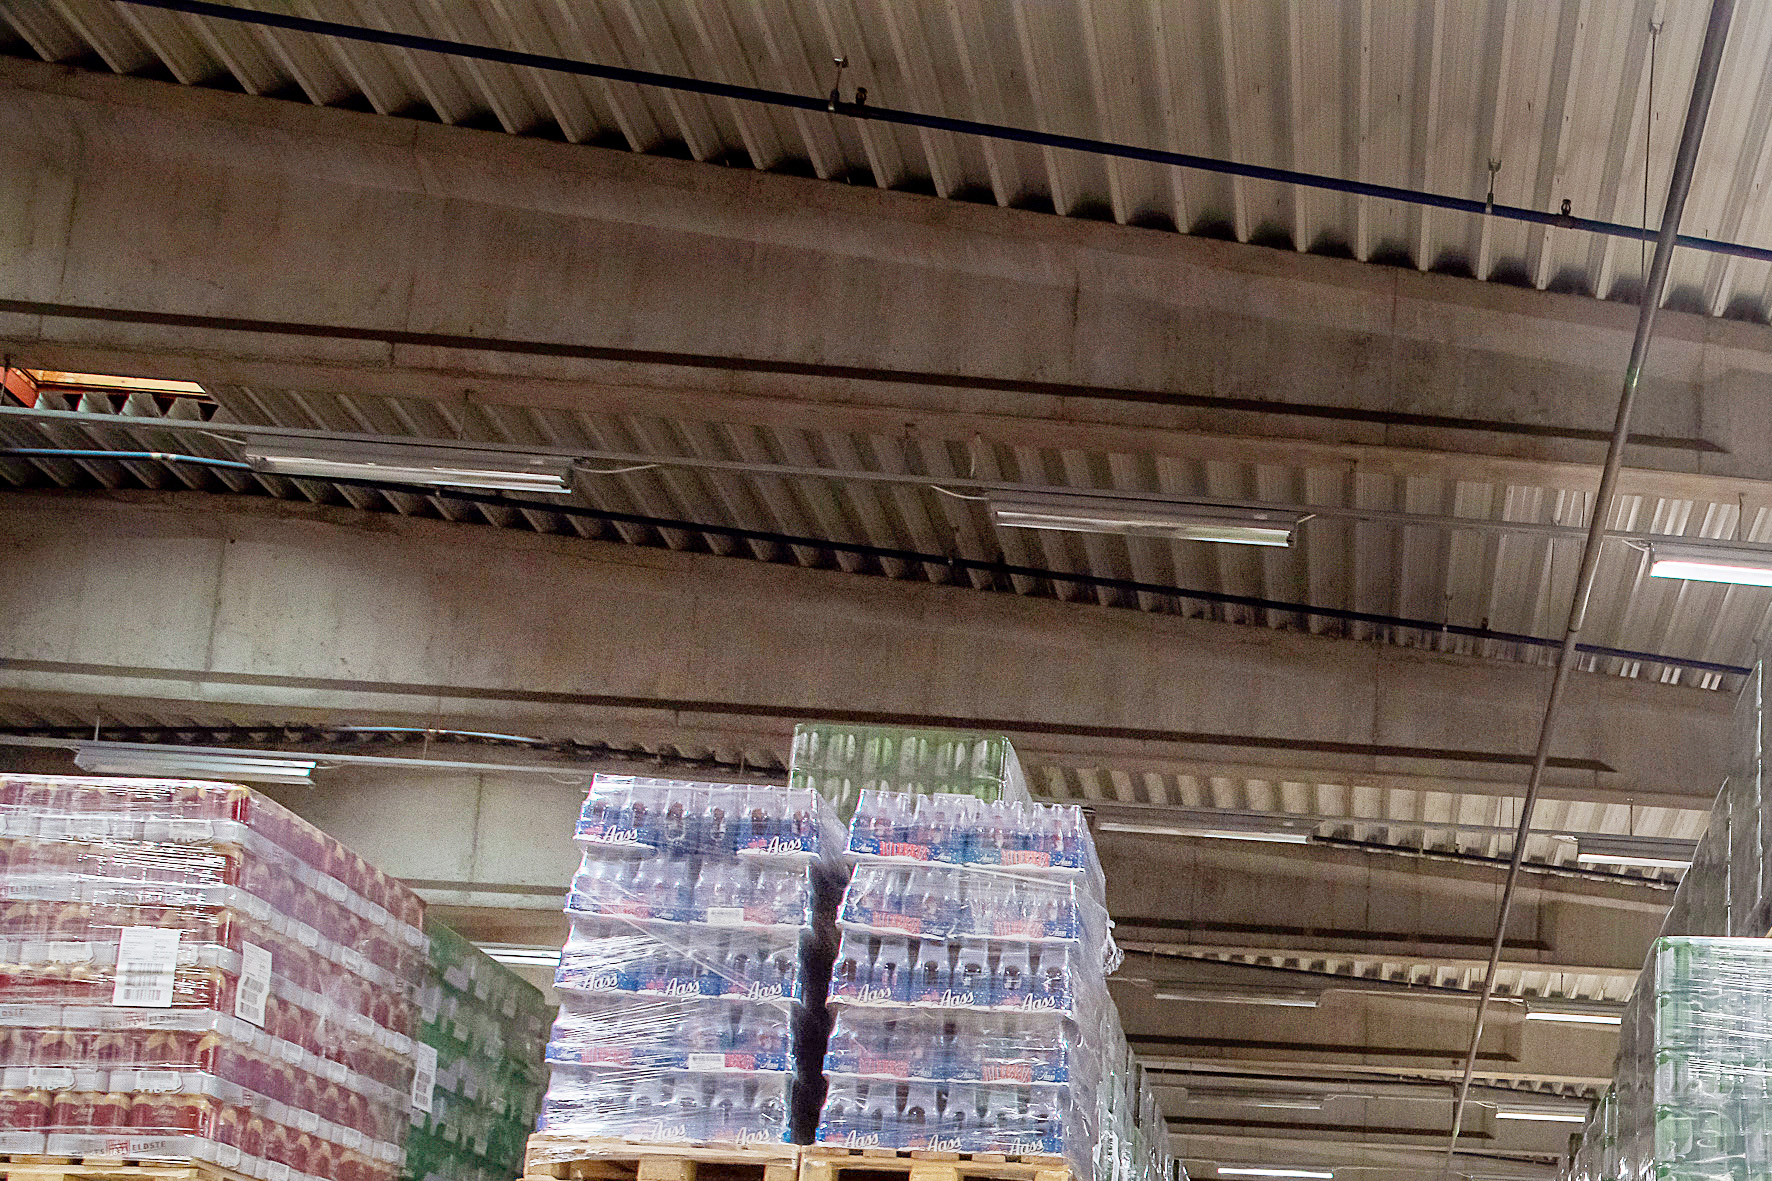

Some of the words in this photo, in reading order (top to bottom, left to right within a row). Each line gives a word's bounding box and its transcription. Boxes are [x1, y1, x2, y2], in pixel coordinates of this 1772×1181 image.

[603, 826, 638, 843] Aass
[766, 836, 803, 853] Aass
[583, 972, 619, 990] Aass
[665, 977, 701, 995] Aass
[749, 981, 783, 999] Aass
[857, 984, 892, 1001] Aass
[940, 989, 975, 1006] Aass
[1023, 993, 1056, 1011] Aass
[648, 1122, 687, 1140] Aass
[735, 1127, 771, 1145] Aass
[845, 1130, 880, 1148] Aass
[928, 1135, 963, 1152] Aass
[1009, 1138, 1044, 1155] Aass
